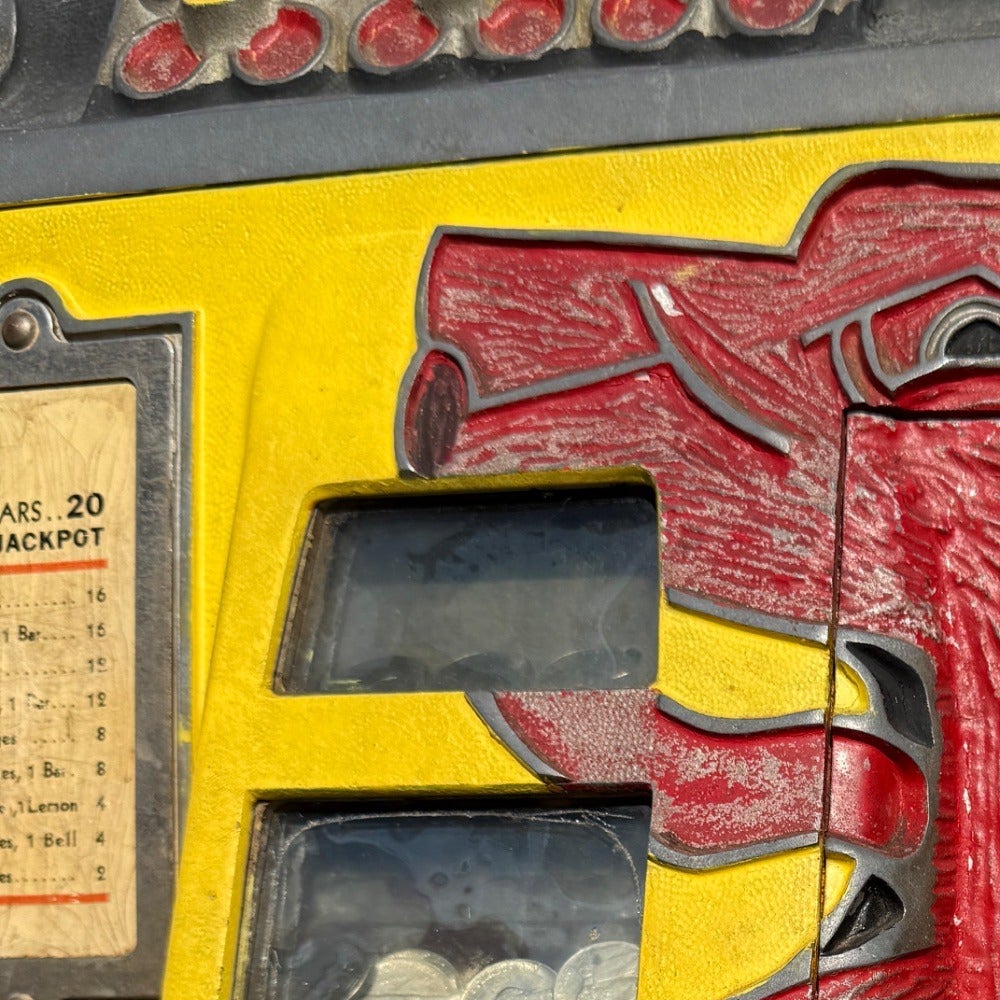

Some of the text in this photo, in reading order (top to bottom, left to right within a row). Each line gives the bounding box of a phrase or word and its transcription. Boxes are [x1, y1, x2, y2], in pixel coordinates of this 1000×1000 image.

[67, 492, 105, 519] 20
[0, 527, 105, 553] JACKPOT
[86, 587, 107, 604] 16
[86, 691, 107, 708] 12
[96, 726, 107, 742] 8
[27, 799, 79, 814] Lemon
[43, 829, 77, 848] Bell
[95, 831, 105, 847] 4
[96, 865, 107, 881] 2
